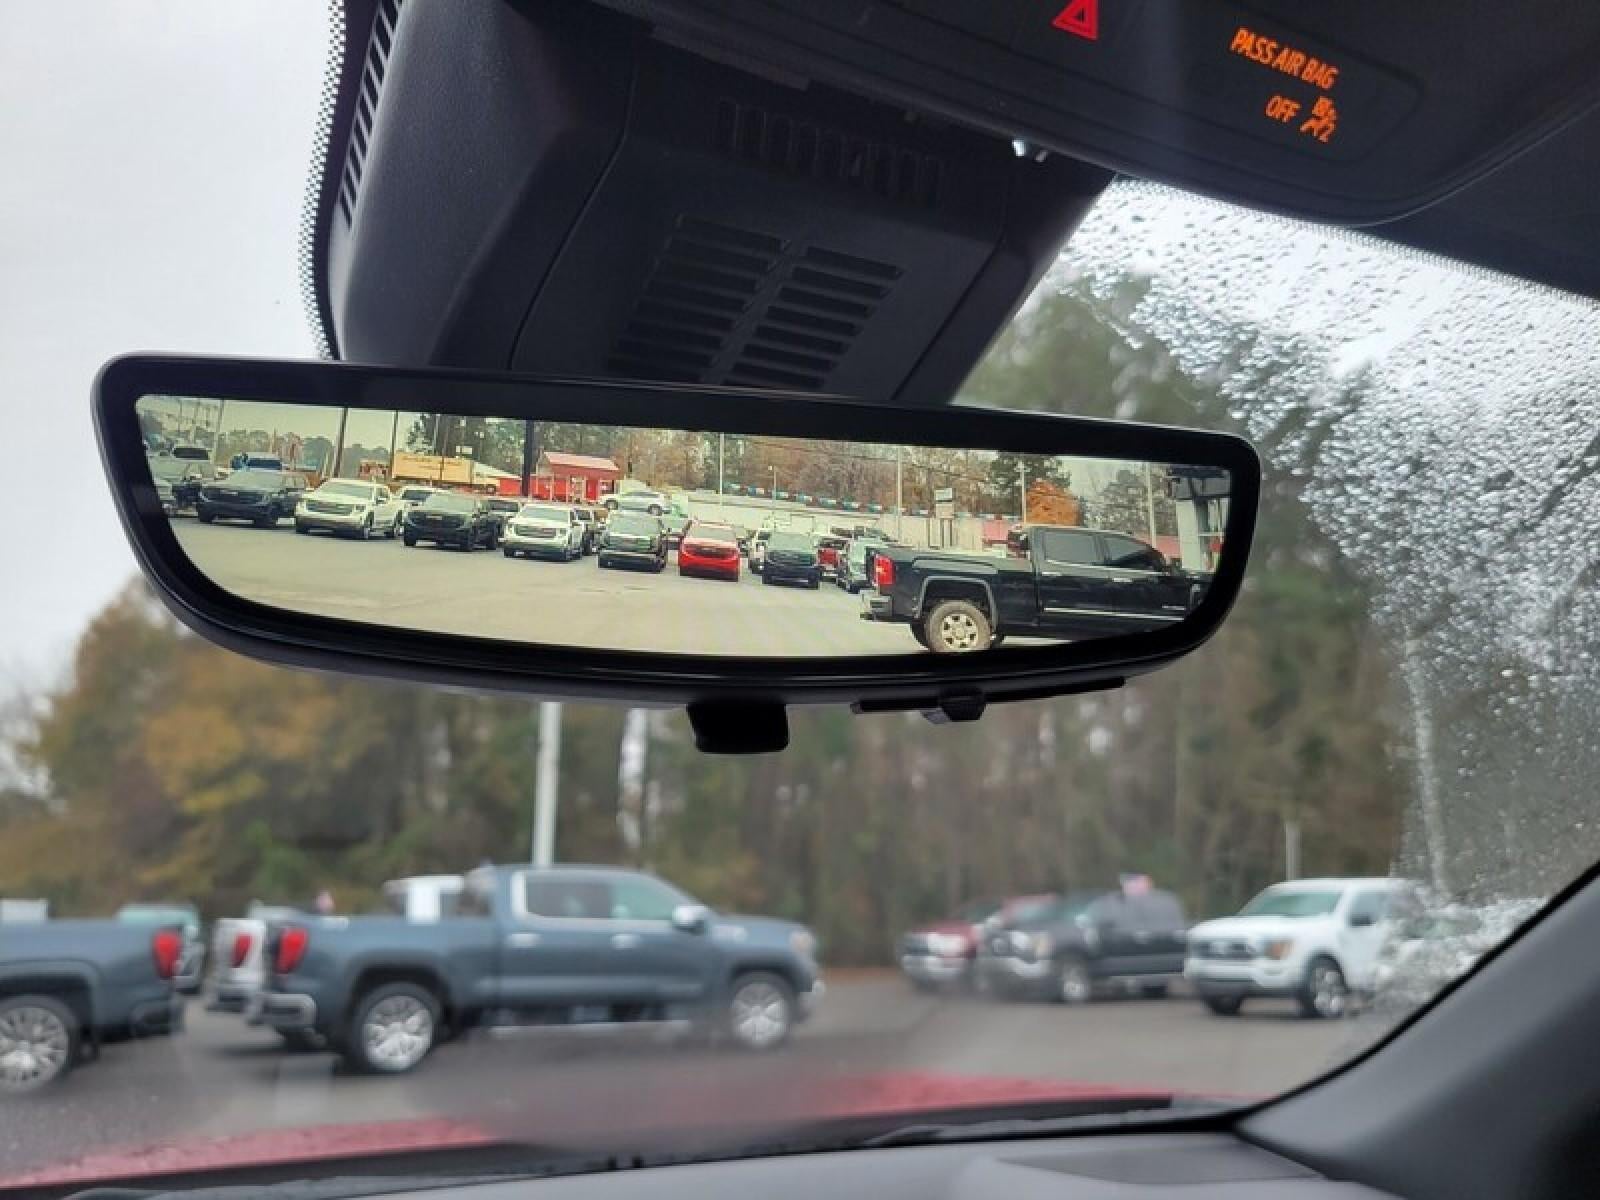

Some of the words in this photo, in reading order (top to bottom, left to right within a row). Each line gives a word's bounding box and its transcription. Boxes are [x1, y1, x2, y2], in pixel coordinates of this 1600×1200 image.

[1230, 26, 1278, 64] PASS
[1272, 47, 1306, 77] AIR
[1301, 57, 1340, 89] BAG
[1264, 95, 1301, 123] OFF
